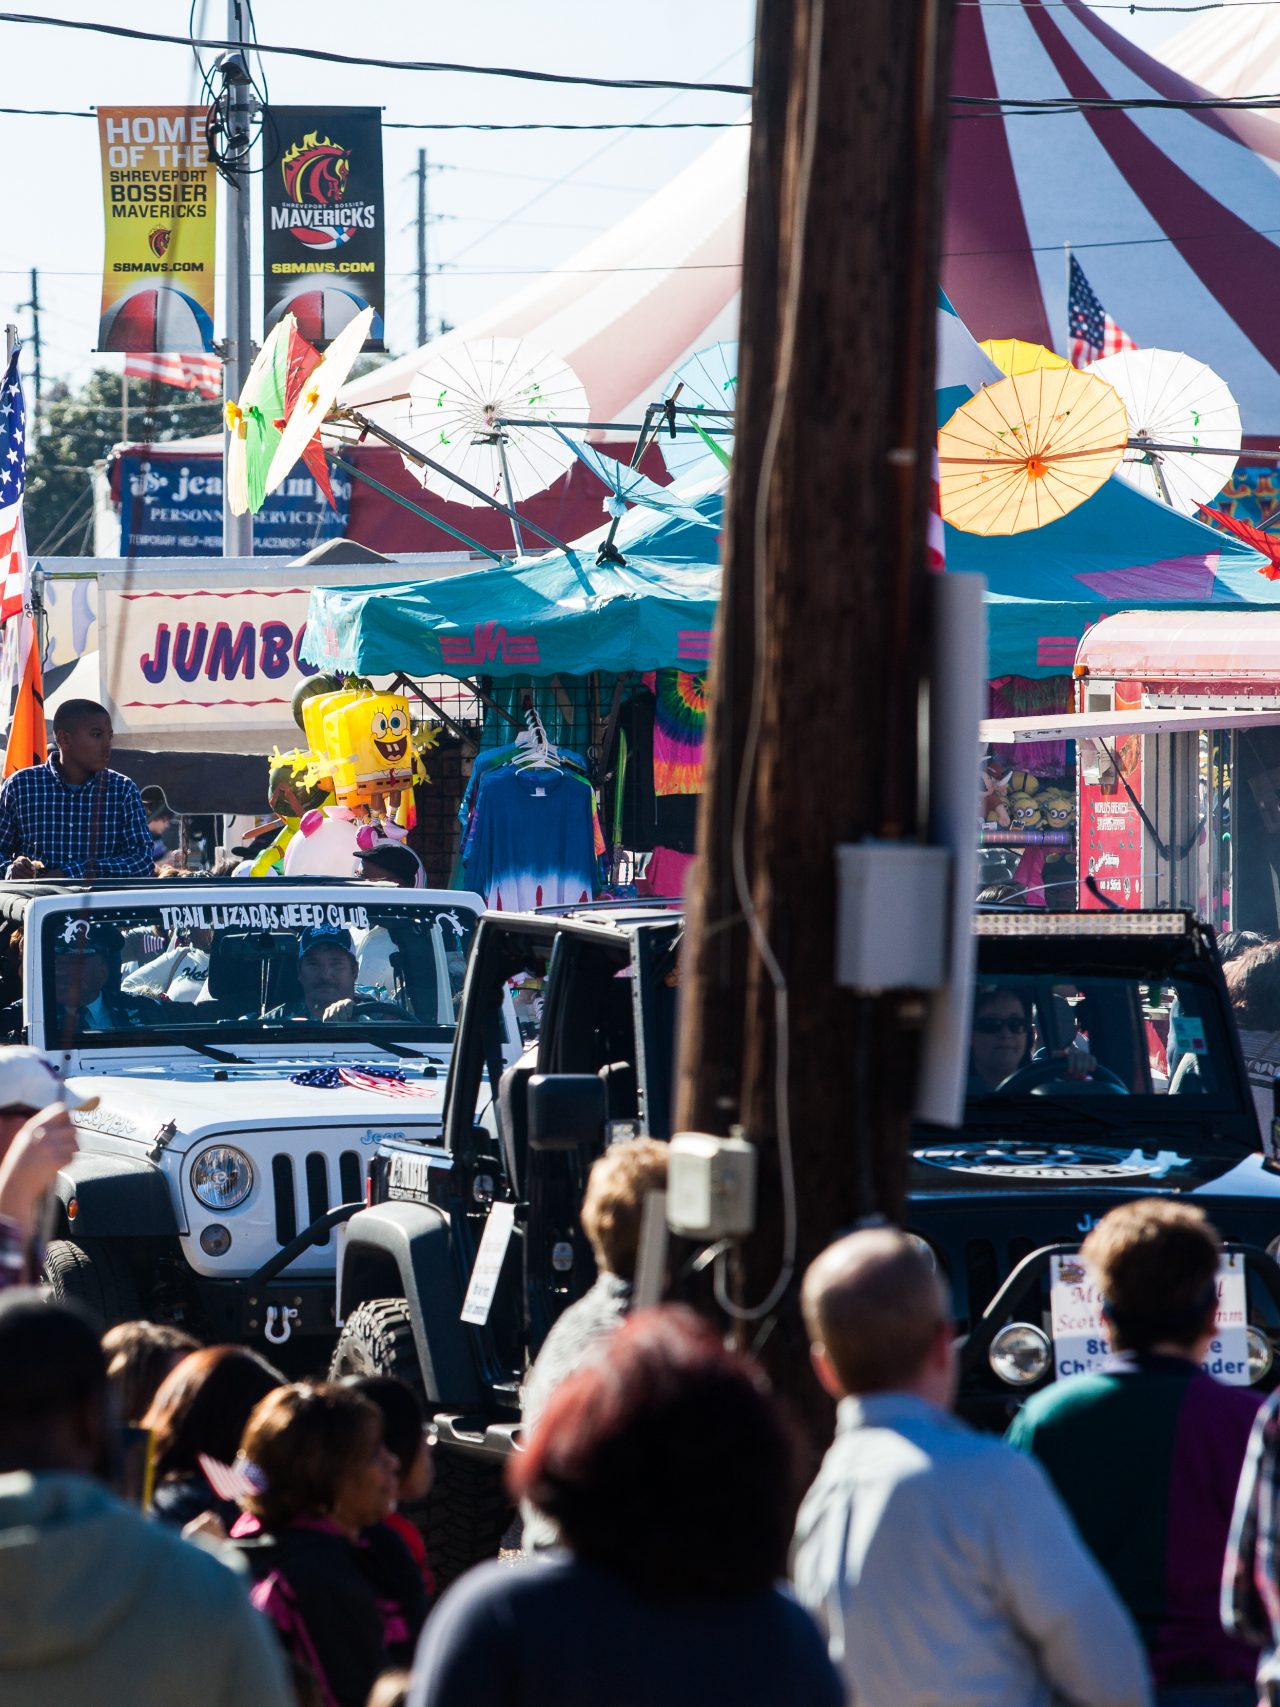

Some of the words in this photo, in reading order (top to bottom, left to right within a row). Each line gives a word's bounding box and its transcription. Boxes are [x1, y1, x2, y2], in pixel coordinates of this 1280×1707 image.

[106, 116, 208, 143] HOME
[108, 145, 145, 168] OF
[153, 144, 208, 167] THE
[110, 170, 207, 182] SHREVEPORT
[111, 184, 207, 202] BOSSIER
[112, 204, 207, 218] MAVERICKS
[271, 205, 375, 230] MAVERICKS
[113, 262, 204, 272] SBMAVS.COM
[271, 262, 375, 274] SBMAVS.COM
[171, 466, 222, 501] jea
[150, 508, 222, 521] PERSONN
[160, 905, 211, 930] TRAIL
[211, 904, 279, 930] LIZARDS
[279, 904, 324, 928] JEEP
[326, 904, 369, 929] CLUB
